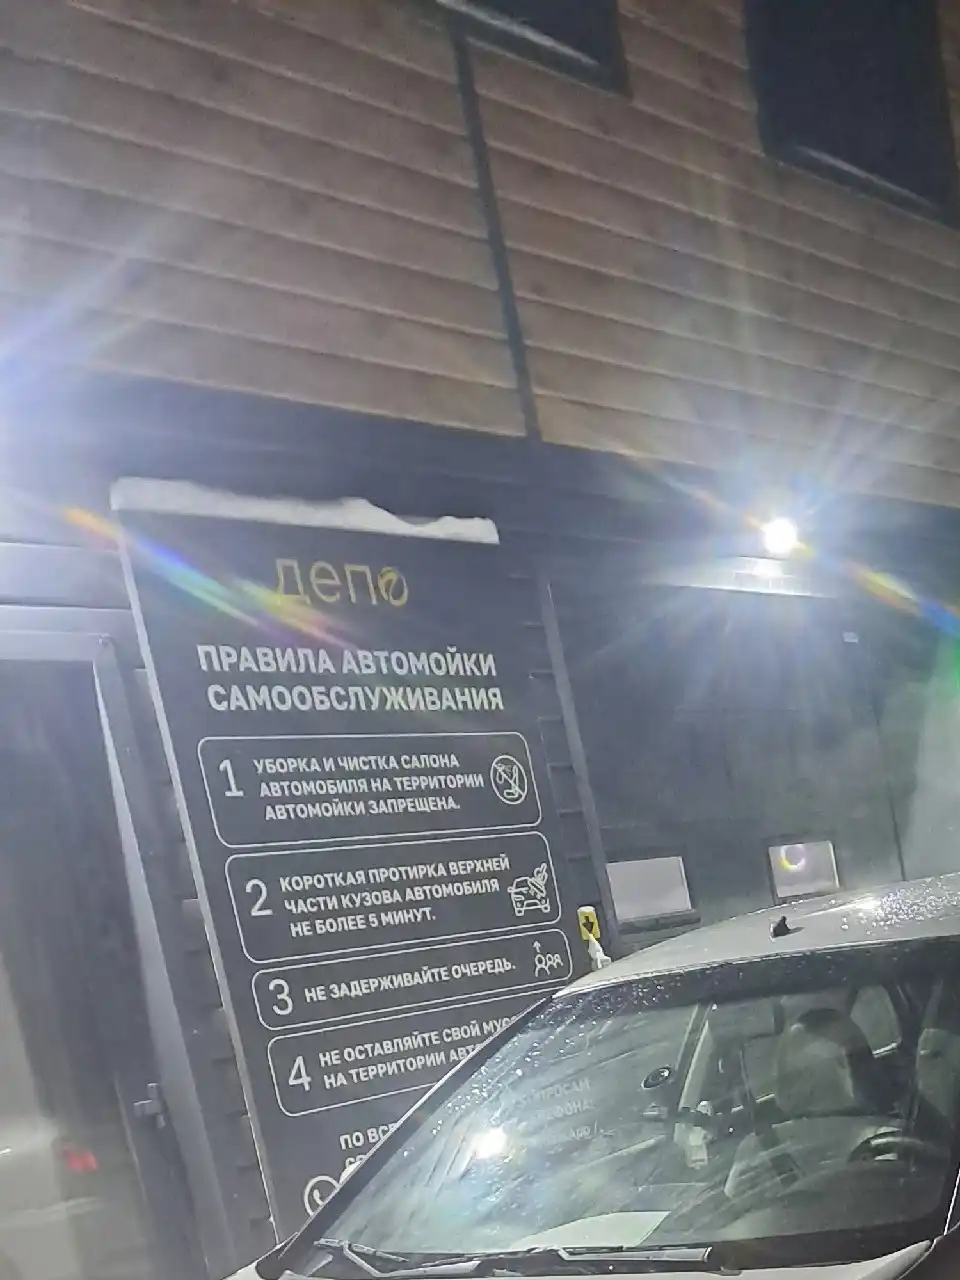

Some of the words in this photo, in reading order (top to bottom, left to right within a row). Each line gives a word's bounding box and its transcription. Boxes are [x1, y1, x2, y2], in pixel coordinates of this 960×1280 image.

[197, 645, 336, 674] ПРАВИЛА
[342, 645, 497, 678] АВТОМОЙКИ
[207, 683, 505, 712] САМООБСЛУЖИВАНИЯ
[218, 759, 244, 798] 1
[253, 756, 322, 775] УБОРКА
[323, 756, 336, 772] И
[337, 754, 400, 772] ЧИСТКА
[401, 752, 460, 770] САЛОНА
[259, 778, 369, 799] АВТОМОБИЛЯ
[370, 777, 394, 794] НА
[394, 773, 485, 792] ТЕРРИТОРИИ
[265, 798, 366, 821] АВТОМОЙКИ
[368, 797, 461, 817] ЗАПРЕЩЕНА.
[279, 870, 366, 893] КОРОТКАЯ
[368, 861, 447, 885] ПРОТИРКА
[449, 853, 511, 876] ВЕРХНЕЙ
[244, 878, 274, 917] 2
[284, 894, 339, 915] ЧАСТИ
[341, 888, 404, 909] КУЗОВА
[404, 878, 500, 902] АВТОМОБИЛЯ
[290, 921, 312, 938] НЕ
[313, 914, 367, 935] БОЛЕЕ
[368, 912, 379, 928] 5
[380, 905, 437, 928] МИНУТ.
[268, 978, 294, 1016] 3
[304, 985, 328, 1004] НЕ
[329, 966, 450, 999] ЗАДЕРЖИВАЙТЕ
[451, 957, 517, 980] ОЧЕРЕДЬ.
[319, 1049, 342, 1068] НЕ
[344, 1030, 441, 1062] ОСТАВЛЯЙТЕ
[443, 1020, 481, 1043] СВОЙ
[287, 1055, 312, 1092] 4
[324, 1072, 348, 1090] НА
[349, 1052, 447, 1084] ТЕРРИТОРИИ
[339, 1131, 365, 1150] ПО
